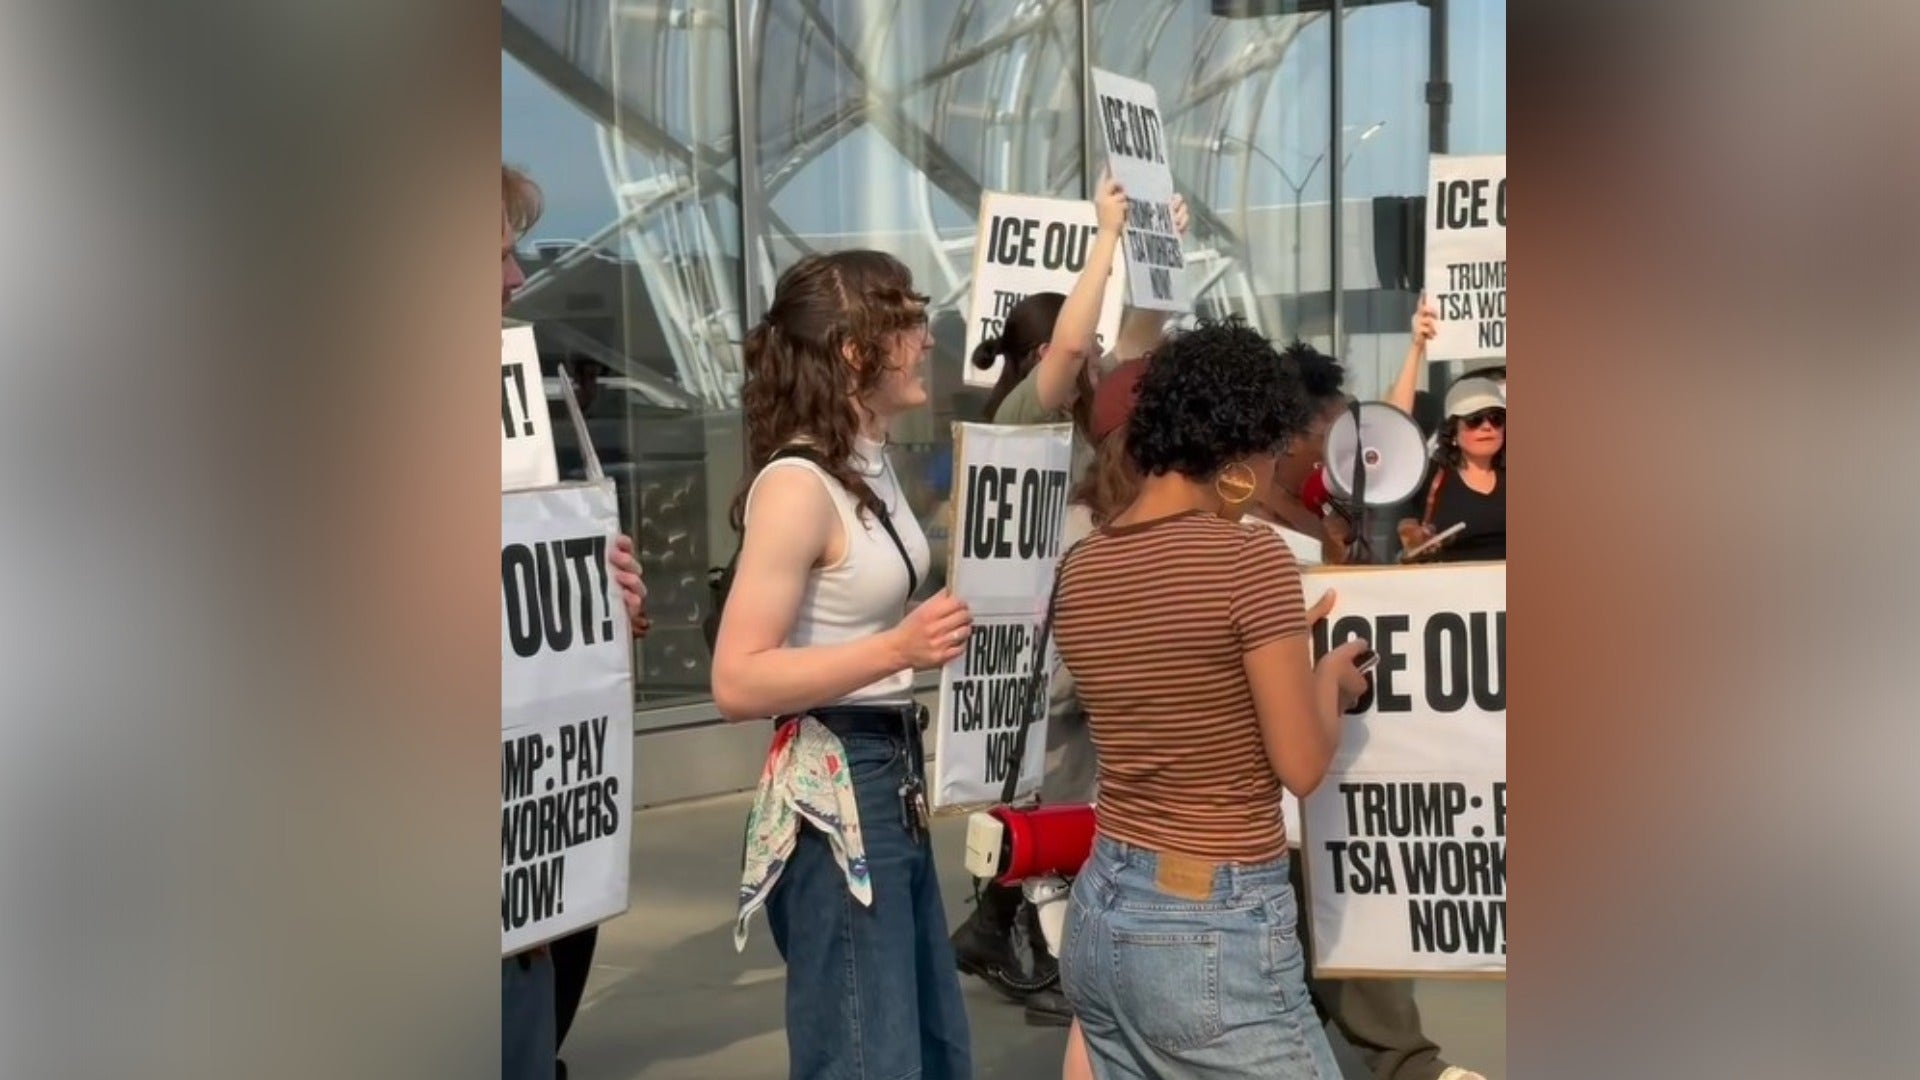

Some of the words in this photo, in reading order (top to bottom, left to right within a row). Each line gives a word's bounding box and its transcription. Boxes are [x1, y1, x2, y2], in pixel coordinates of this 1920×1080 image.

[1101, 94, 1132, 157] ICE
[1436, 179, 1489, 230] ICE
[987, 215, 1040, 267] ICE
[1437, 293, 1472, 321] TSA
[962, 465, 1016, 559] ICE
[1018, 468, 1067, 559] OUT!
[502, 535, 614, 657] OUT!
[964, 624, 1030, 677] TRUMP:
[952, 680, 984, 732] TSA
[501, 733, 554, 801] MP:
[559, 716, 608, 786] PAY
[1340, 782, 1484, 838] TRUMP:
[1326, 841, 1397, 895] TSA
